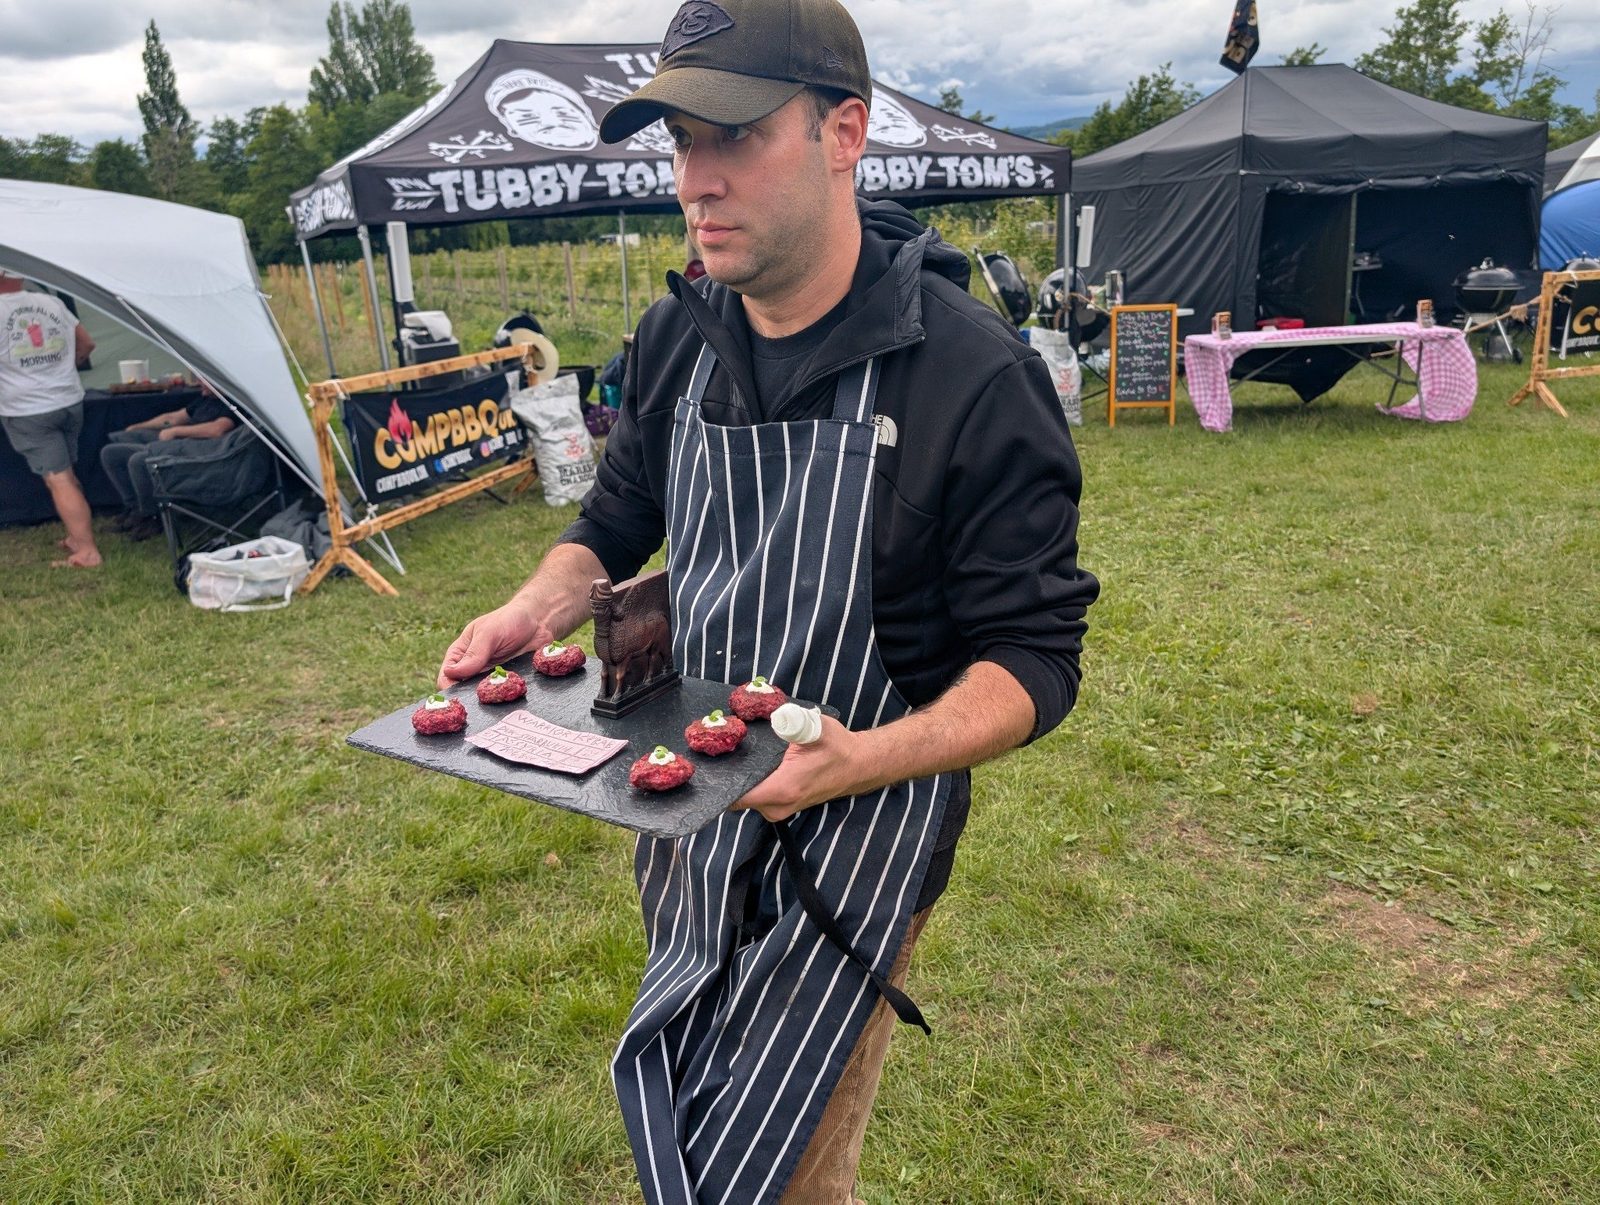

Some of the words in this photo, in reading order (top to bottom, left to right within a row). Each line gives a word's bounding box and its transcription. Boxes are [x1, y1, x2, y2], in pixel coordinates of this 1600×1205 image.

[937, 155, 1036, 189] TOM'S
[429, 161, 588, 213] TUBBY
[20, 353, 62, 367] MORNING
[518, 714, 571, 738] WARRIOR
